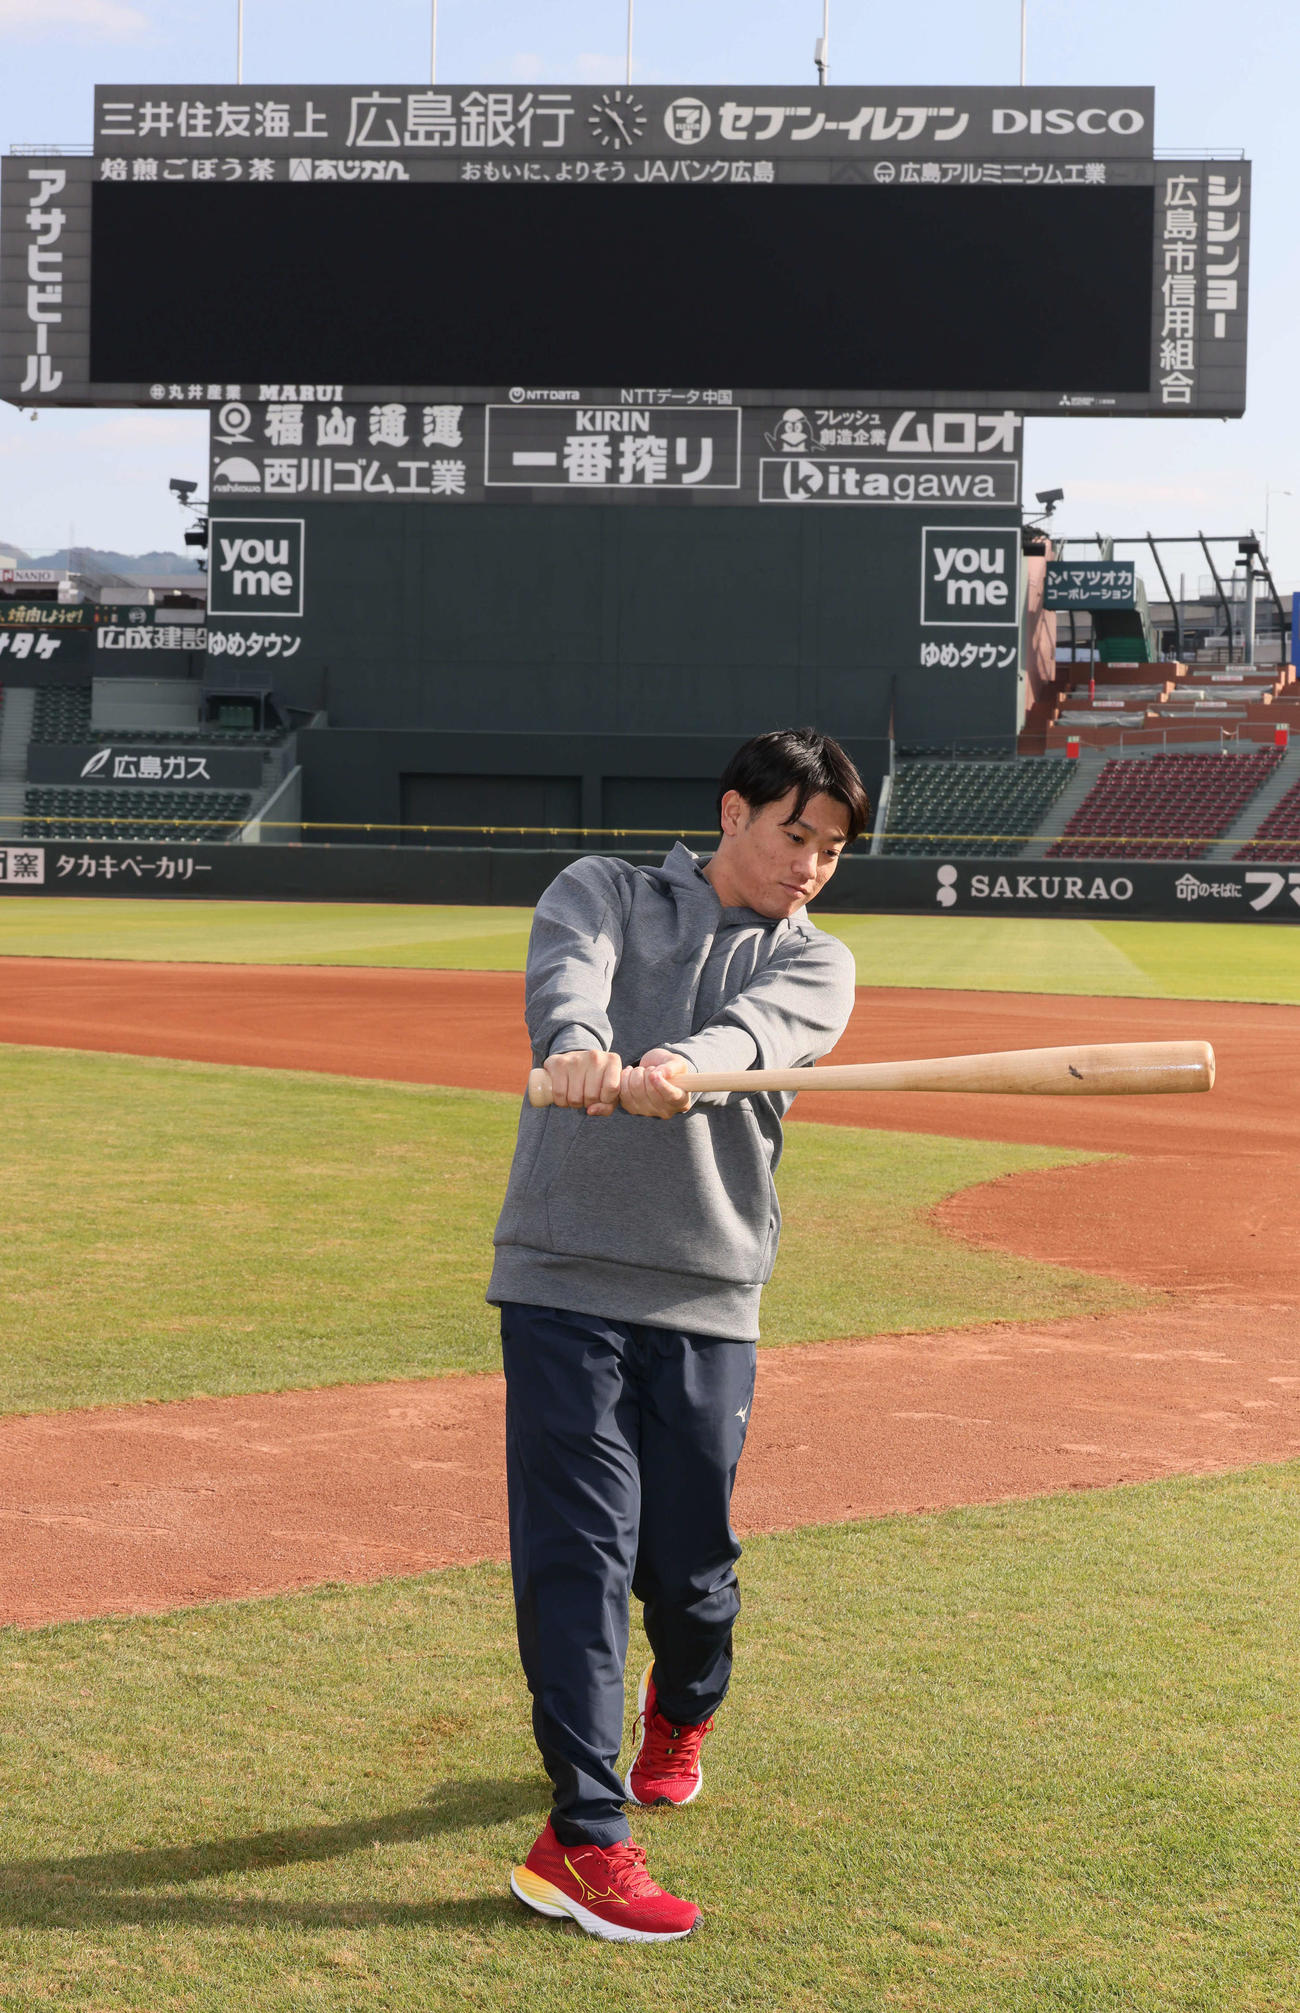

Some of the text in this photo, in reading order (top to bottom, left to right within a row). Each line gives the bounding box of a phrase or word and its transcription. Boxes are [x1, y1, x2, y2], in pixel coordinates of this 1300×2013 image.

[100, 101, 328, 138] 三井住友海上
[346, 90, 575, 147] 広島銀行
[992, 108, 1145, 135] DISCO
[100, 158, 276, 182] 焙煎ごぼう茶
[314, 160, 410, 181] あじかん
[461, 161, 775, 183] おもいに、よりそう JAバンク広島
[899, 162, 1107, 184] 広島アルミニウム工業
[1206, 175, 1241, 338] シシンヨー
[21, 169, 67, 392] アサヒビール
[1160, 175, 1199, 404] 広島市信用組合
[168, 384, 241, 400] 丸井産業
[258, 385, 343, 401] MARUI
[263, 403, 464, 447] 福山通運
[576, 410, 650, 432] KIRIN
[814, 410, 881, 426] フレッシュ
[819, 429, 887, 446] 創造企業
[886, 410, 1022, 453] ムロオ
[512, 435, 713, 484] 一番搾り
[263, 458, 466, 495] 西川ゴム工業
[220, 538, 289, 572] you
[933, 547, 1005, 581] you
[233, 570, 293, 596] me
[1070, 570, 1132, 586] マツオカ
[947, 578, 1009, 606] me
[1047, 588, 1132, 600] コーポレーション
[97, 625, 207, 650] 広成建設
[208, 632, 300, 658] ゆめタウン
[920, 642, 1017, 668] ゆめタウン
[113, 755, 211, 780] 広島ガス
[56, 855, 212, 879] タカキベーカリー
[970, 874, 1134, 900] SAKURAO
[1174, 873, 1242, 902] 命のそばに
